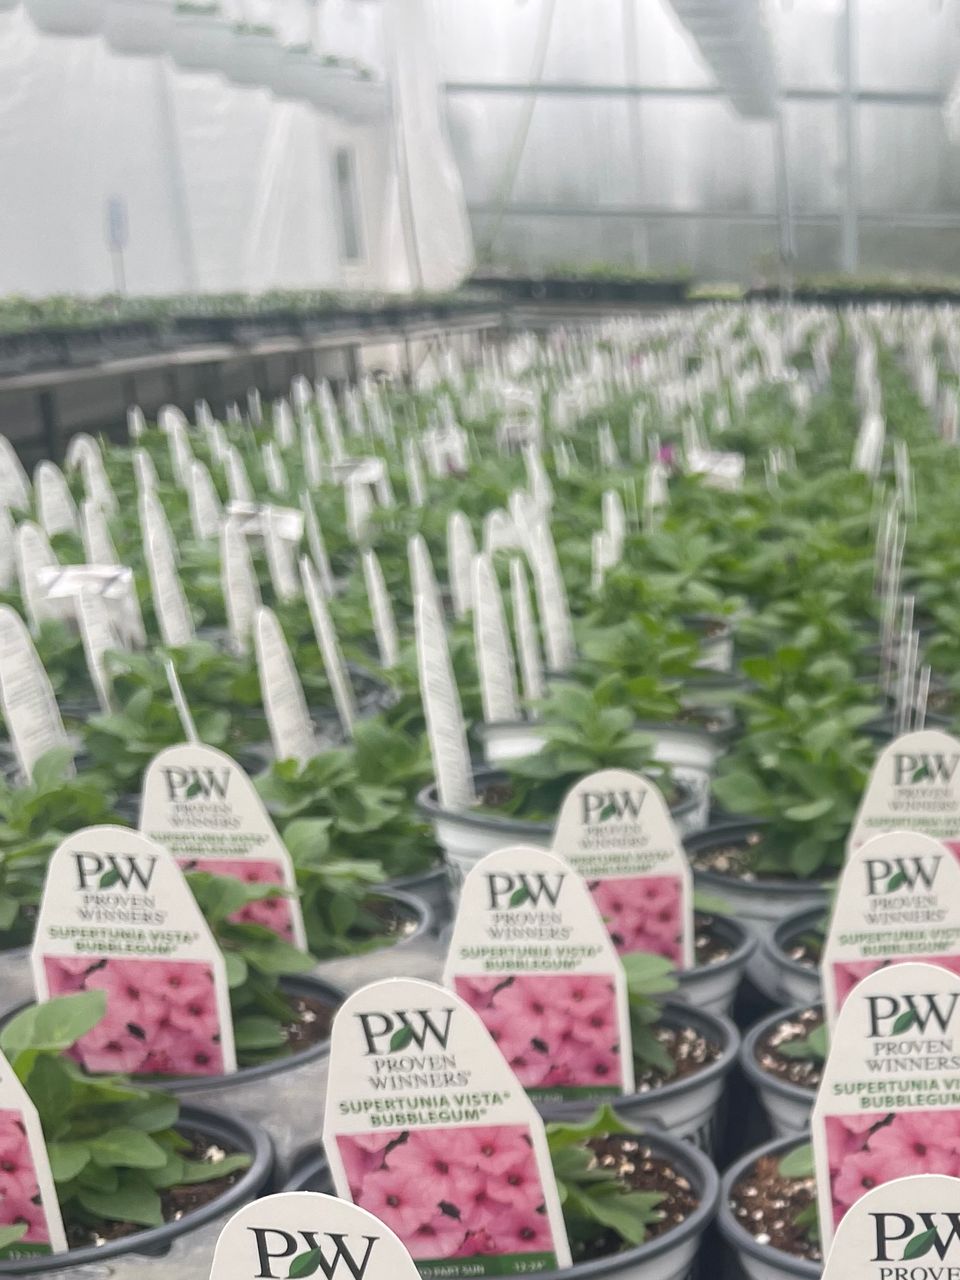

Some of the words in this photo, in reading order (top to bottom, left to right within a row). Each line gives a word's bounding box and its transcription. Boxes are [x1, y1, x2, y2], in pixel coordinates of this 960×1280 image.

[161, 765, 232, 801] PW
[578, 789, 649, 825] PW
[72, 851, 159, 891] PW
[864, 855, 944, 896] PW
[484, 871, 567, 911] PW
[354, 1008, 456, 1055] PW
[873, 1039, 953, 1056] PROVEN
[374, 1055, 456, 1074] PROVEN
[340, 1094, 450, 1115] SUPERTUNIA
[833, 1079, 937, 1095] SUPERTUNIA
